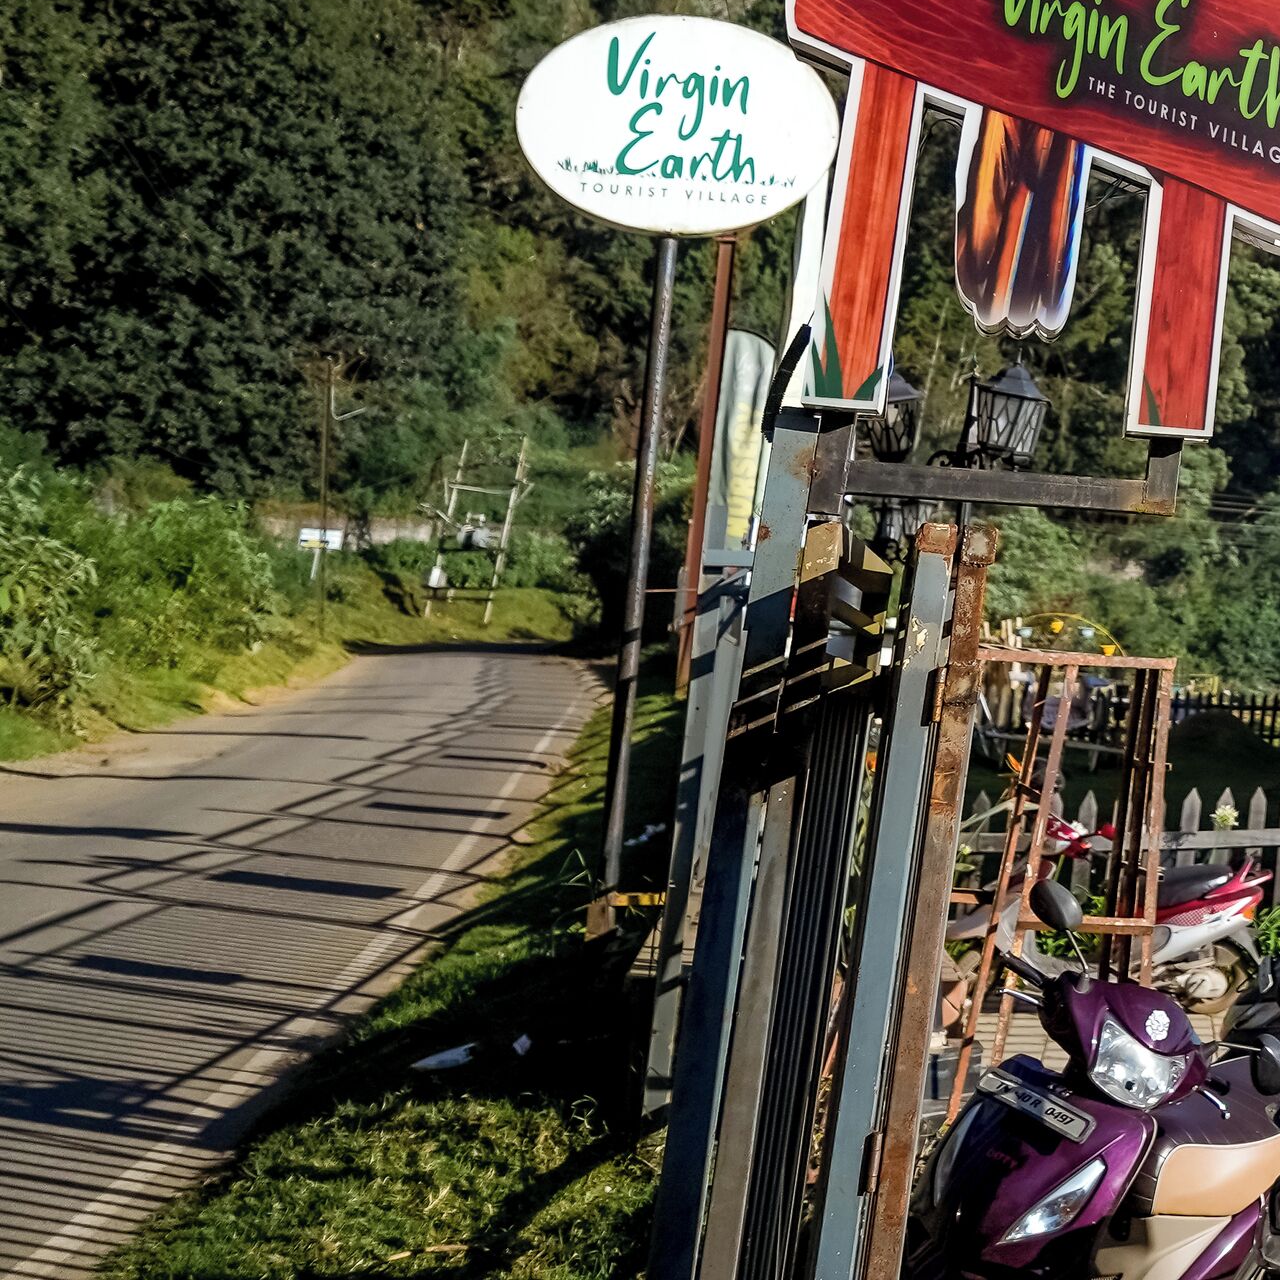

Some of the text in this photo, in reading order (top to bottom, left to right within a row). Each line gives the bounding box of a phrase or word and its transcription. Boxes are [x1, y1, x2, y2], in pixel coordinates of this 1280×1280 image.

[607, 31, 750, 141] Virgin
[1088, 76, 1116, 99] THE
[1125, 90, 1199, 130] TOURIST
[614, 101, 755, 184] Earth
[580, 182, 768, 205] TOURIST VILLAGE
[1044, 1106, 1076, 1126] 0497
